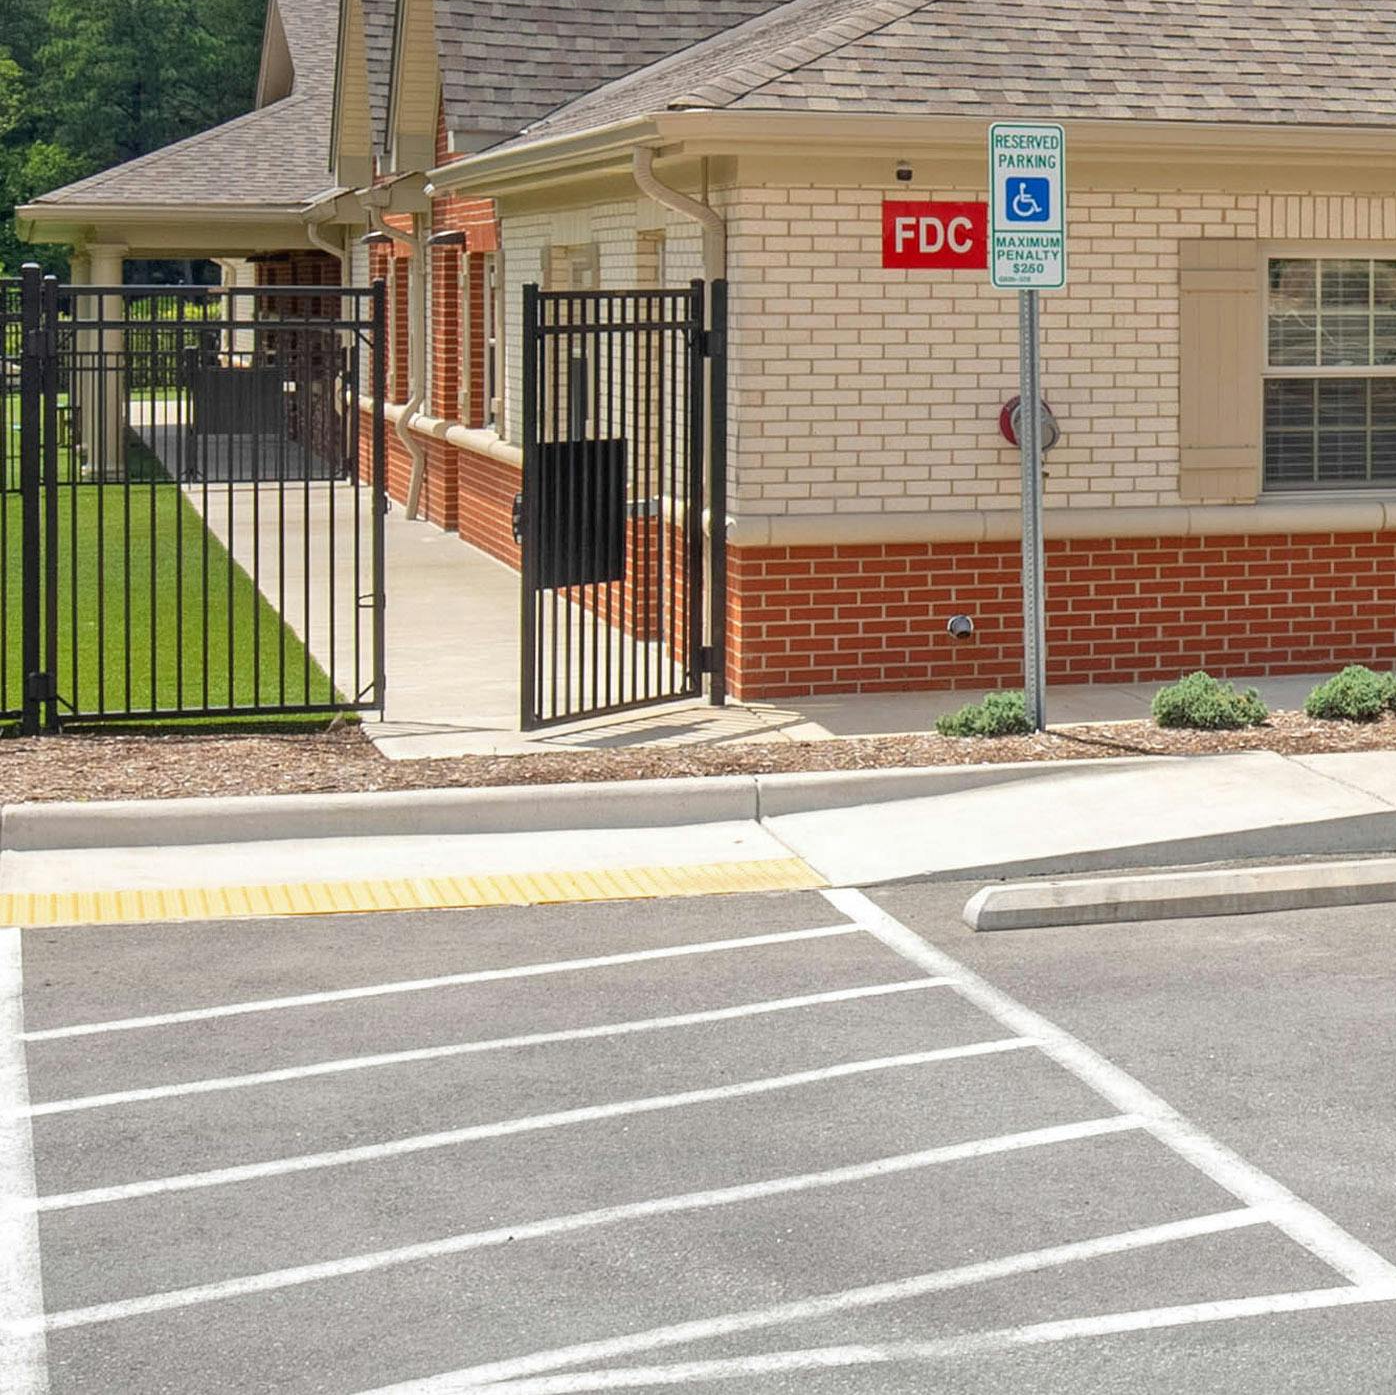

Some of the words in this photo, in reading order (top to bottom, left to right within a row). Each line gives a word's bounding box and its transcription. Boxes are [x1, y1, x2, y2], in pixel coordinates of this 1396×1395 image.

[995, 134, 1059, 150] RESERVED
[999, 154, 1056, 169] PARKING
[894, 216, 974, 253] FDC
[996, 236, 1060, 248] MAXIMUM
[997, 249, 1060, 261] PENALTY
